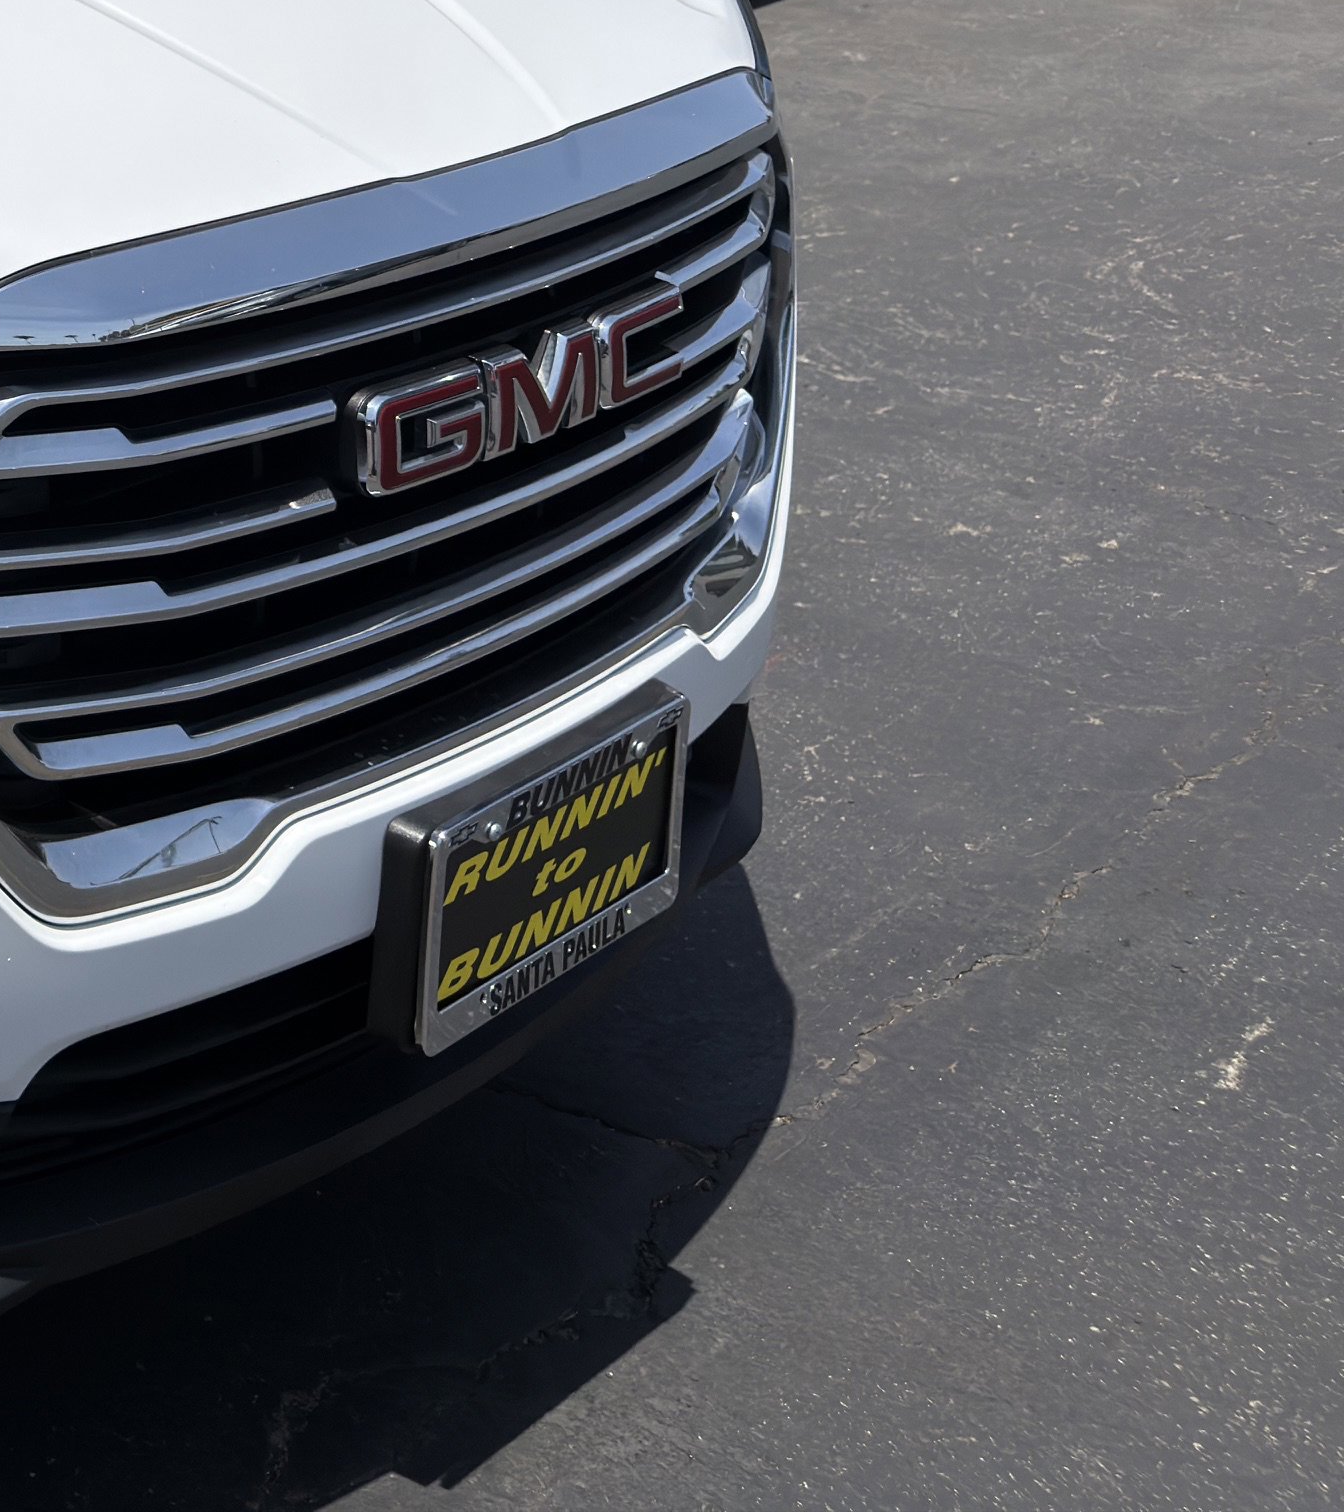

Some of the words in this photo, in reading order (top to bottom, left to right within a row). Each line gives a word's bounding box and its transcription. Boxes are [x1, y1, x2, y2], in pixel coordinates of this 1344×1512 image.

[354, 286, 686, 498] GMC
[442, 747, 668, 907] RUNNIN'
[506, 733, 633, 829] BUNNIN
[437, 842, 652, 1001] BUNNIN
[531, 847, 587, 898] to
[490, 951, 556, 1017] SANTA
[562, 907, 626, 972] PAULA
